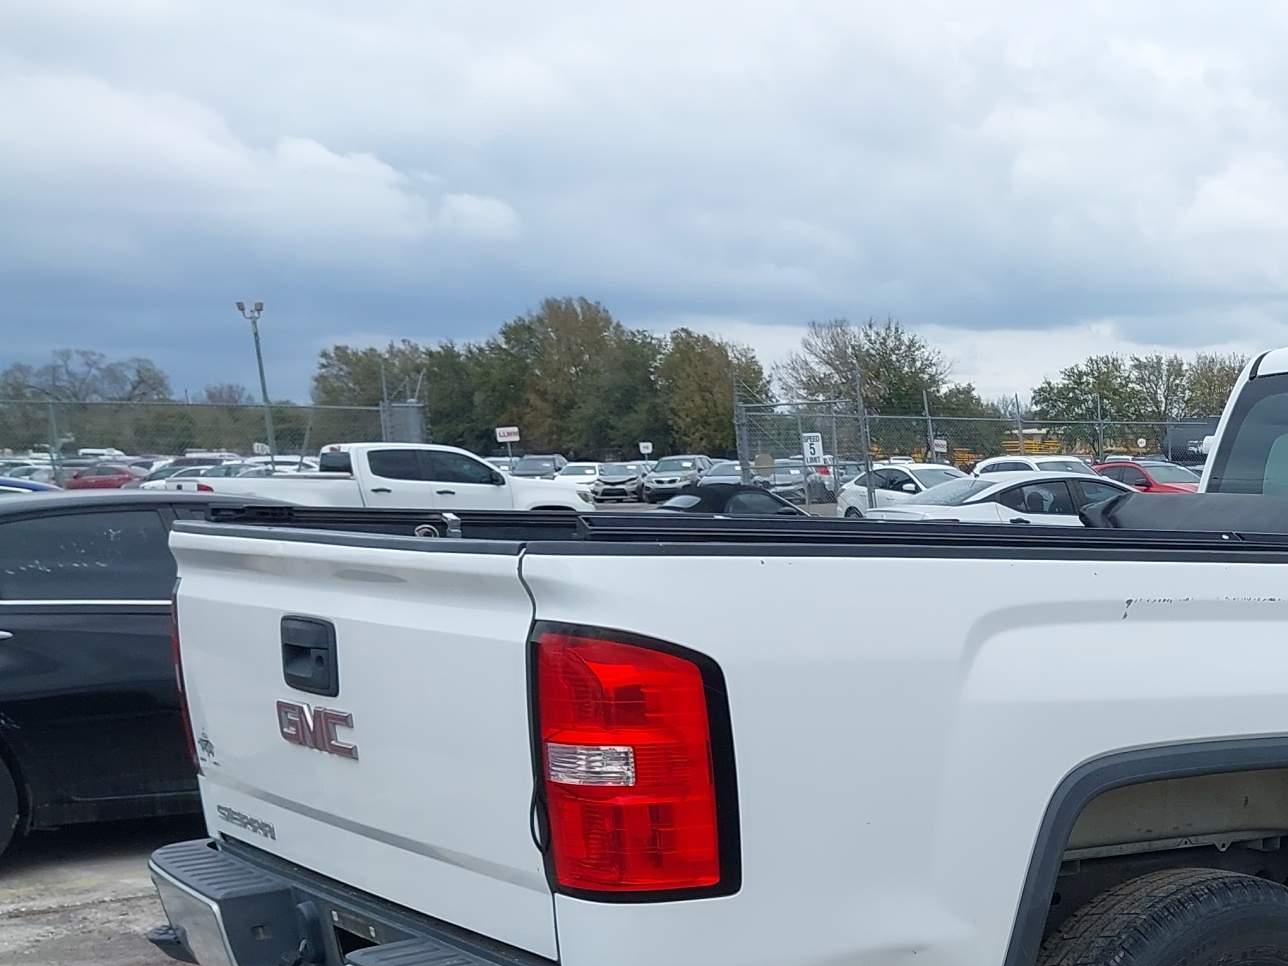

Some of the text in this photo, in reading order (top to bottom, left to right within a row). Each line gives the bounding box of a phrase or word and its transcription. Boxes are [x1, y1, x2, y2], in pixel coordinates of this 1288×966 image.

[810, 443, 816, 456] 5
[276, 700, 359, 761] GMC
[216, 804, 276, 840] SIERRA
